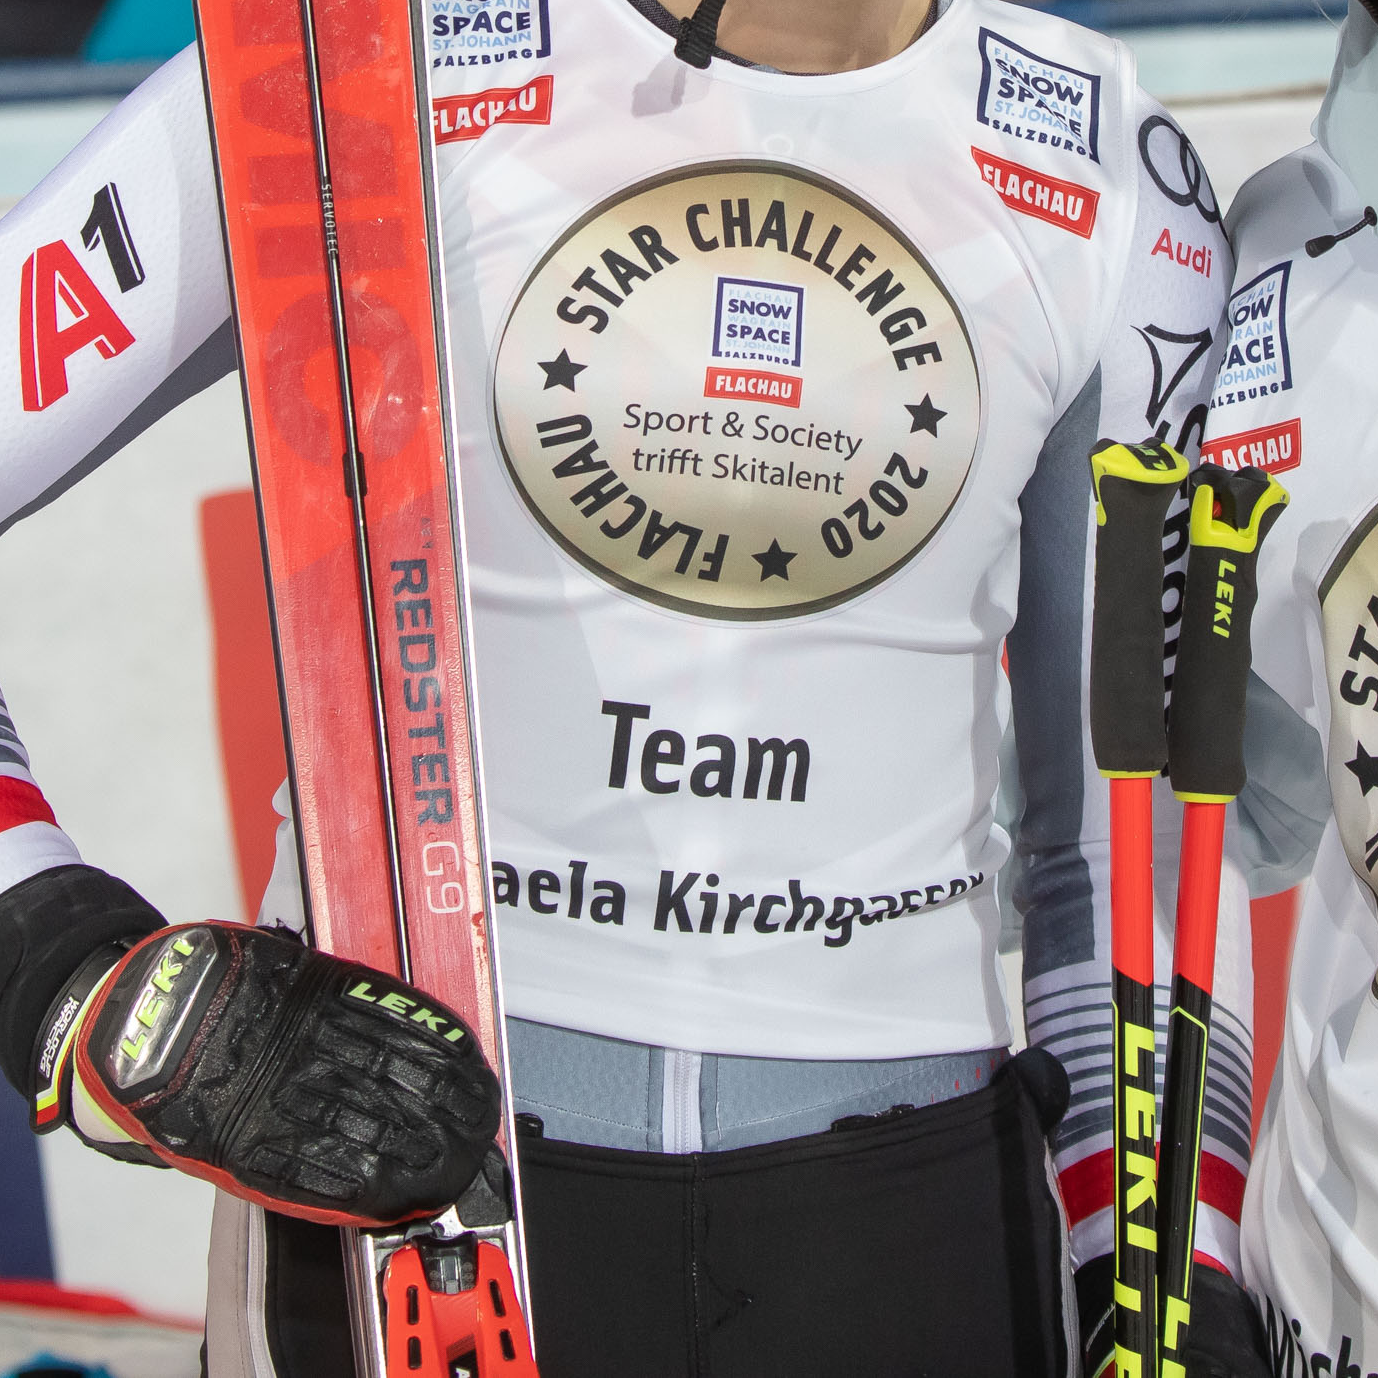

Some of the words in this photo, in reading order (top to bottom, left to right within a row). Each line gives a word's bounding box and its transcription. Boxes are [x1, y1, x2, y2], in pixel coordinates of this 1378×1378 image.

[432, 11, 531, 36] SPACE
[432, 38, 454, 51] ST.
[458, 31, 532, 49] JOHANN
[433, 48, 532, 68] SALZBURG
[994, 47, 1084, 90] FLACHAU
[995, 58, 1084, 106] SNOW
[994, 99, 1015, 116] ST.
[993, 120, 1086, 156] SALZBURG
[983, 163, 1084, 222] FLACHAU
[321, 182, 340, 256] SERVOTEC
[1151, 228, 1212, 278] Audi
[19, 182, 146, 411] A1
[556, 223, 680, 335] STAR
[685, 198, 943, 372] CHALLENGE
[728, 299, 792, 320] SNOW
[726, 324, 791, 346] SPACE
[1232, 294, 1274, 327] OW
[724, 351, 789, 365] SALZBURG
[715, 375, 792, 399] FLACHAU
[623, 403, 713, 436] Sport
[721, 411, 744, 439] &
[753, 415, 863, 461] Society
[632, 448, 703, 477] trifft
[712, 454, 845, 495] Skitalent
[536, 414, 730, 582] FLACHAU
[821, 452, 929, 558] 2020
[1212, 559, 1237, 639] LEKI
[390, 558, 454, 827] REDSTER
[422, 840, 466, 915] G9
[601, 699, 811, 803] Team
[120, 935, 195, 1061] LEKI
[347, 981, 465, 1044] LEKI
[1124, 1022, 1157, 1253] LEKI
